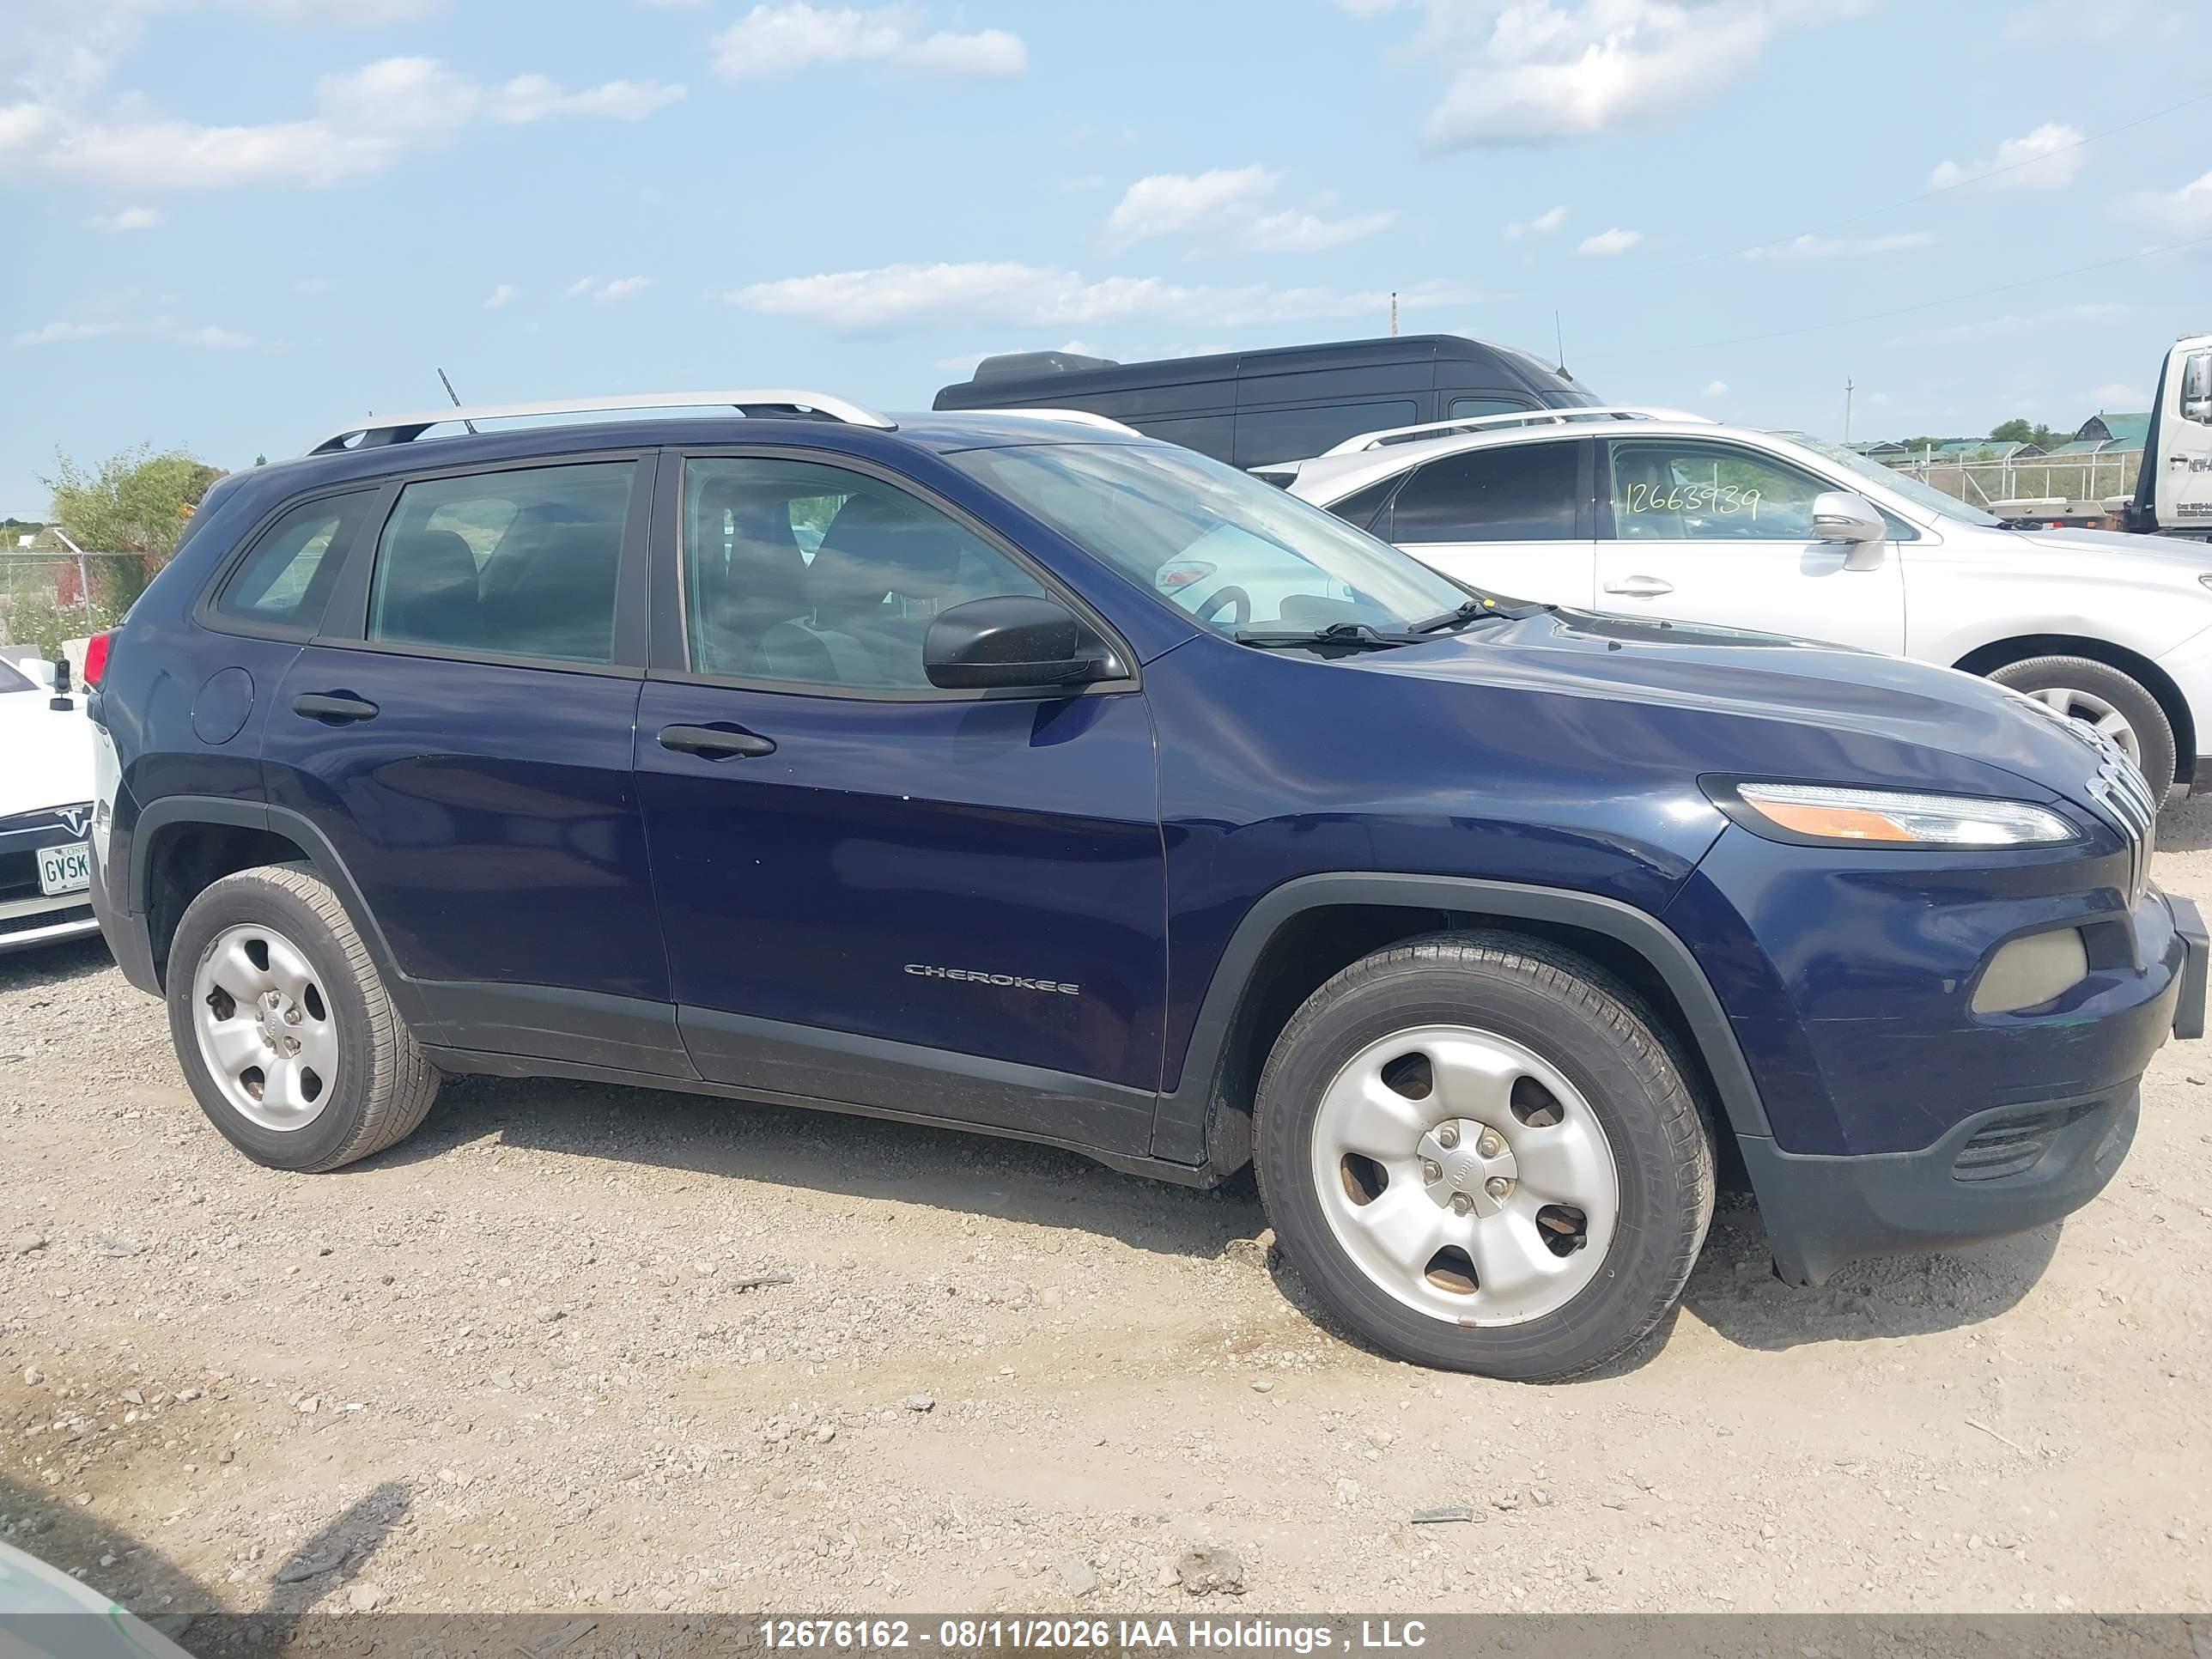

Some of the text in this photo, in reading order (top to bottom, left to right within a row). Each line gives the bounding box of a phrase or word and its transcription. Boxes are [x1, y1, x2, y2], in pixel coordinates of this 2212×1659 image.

[1626, 463, 1762, 521] 12663939
[46, 854, 88, 882] GVSK
[903, 963, 1079, 995] CHEROKEE
